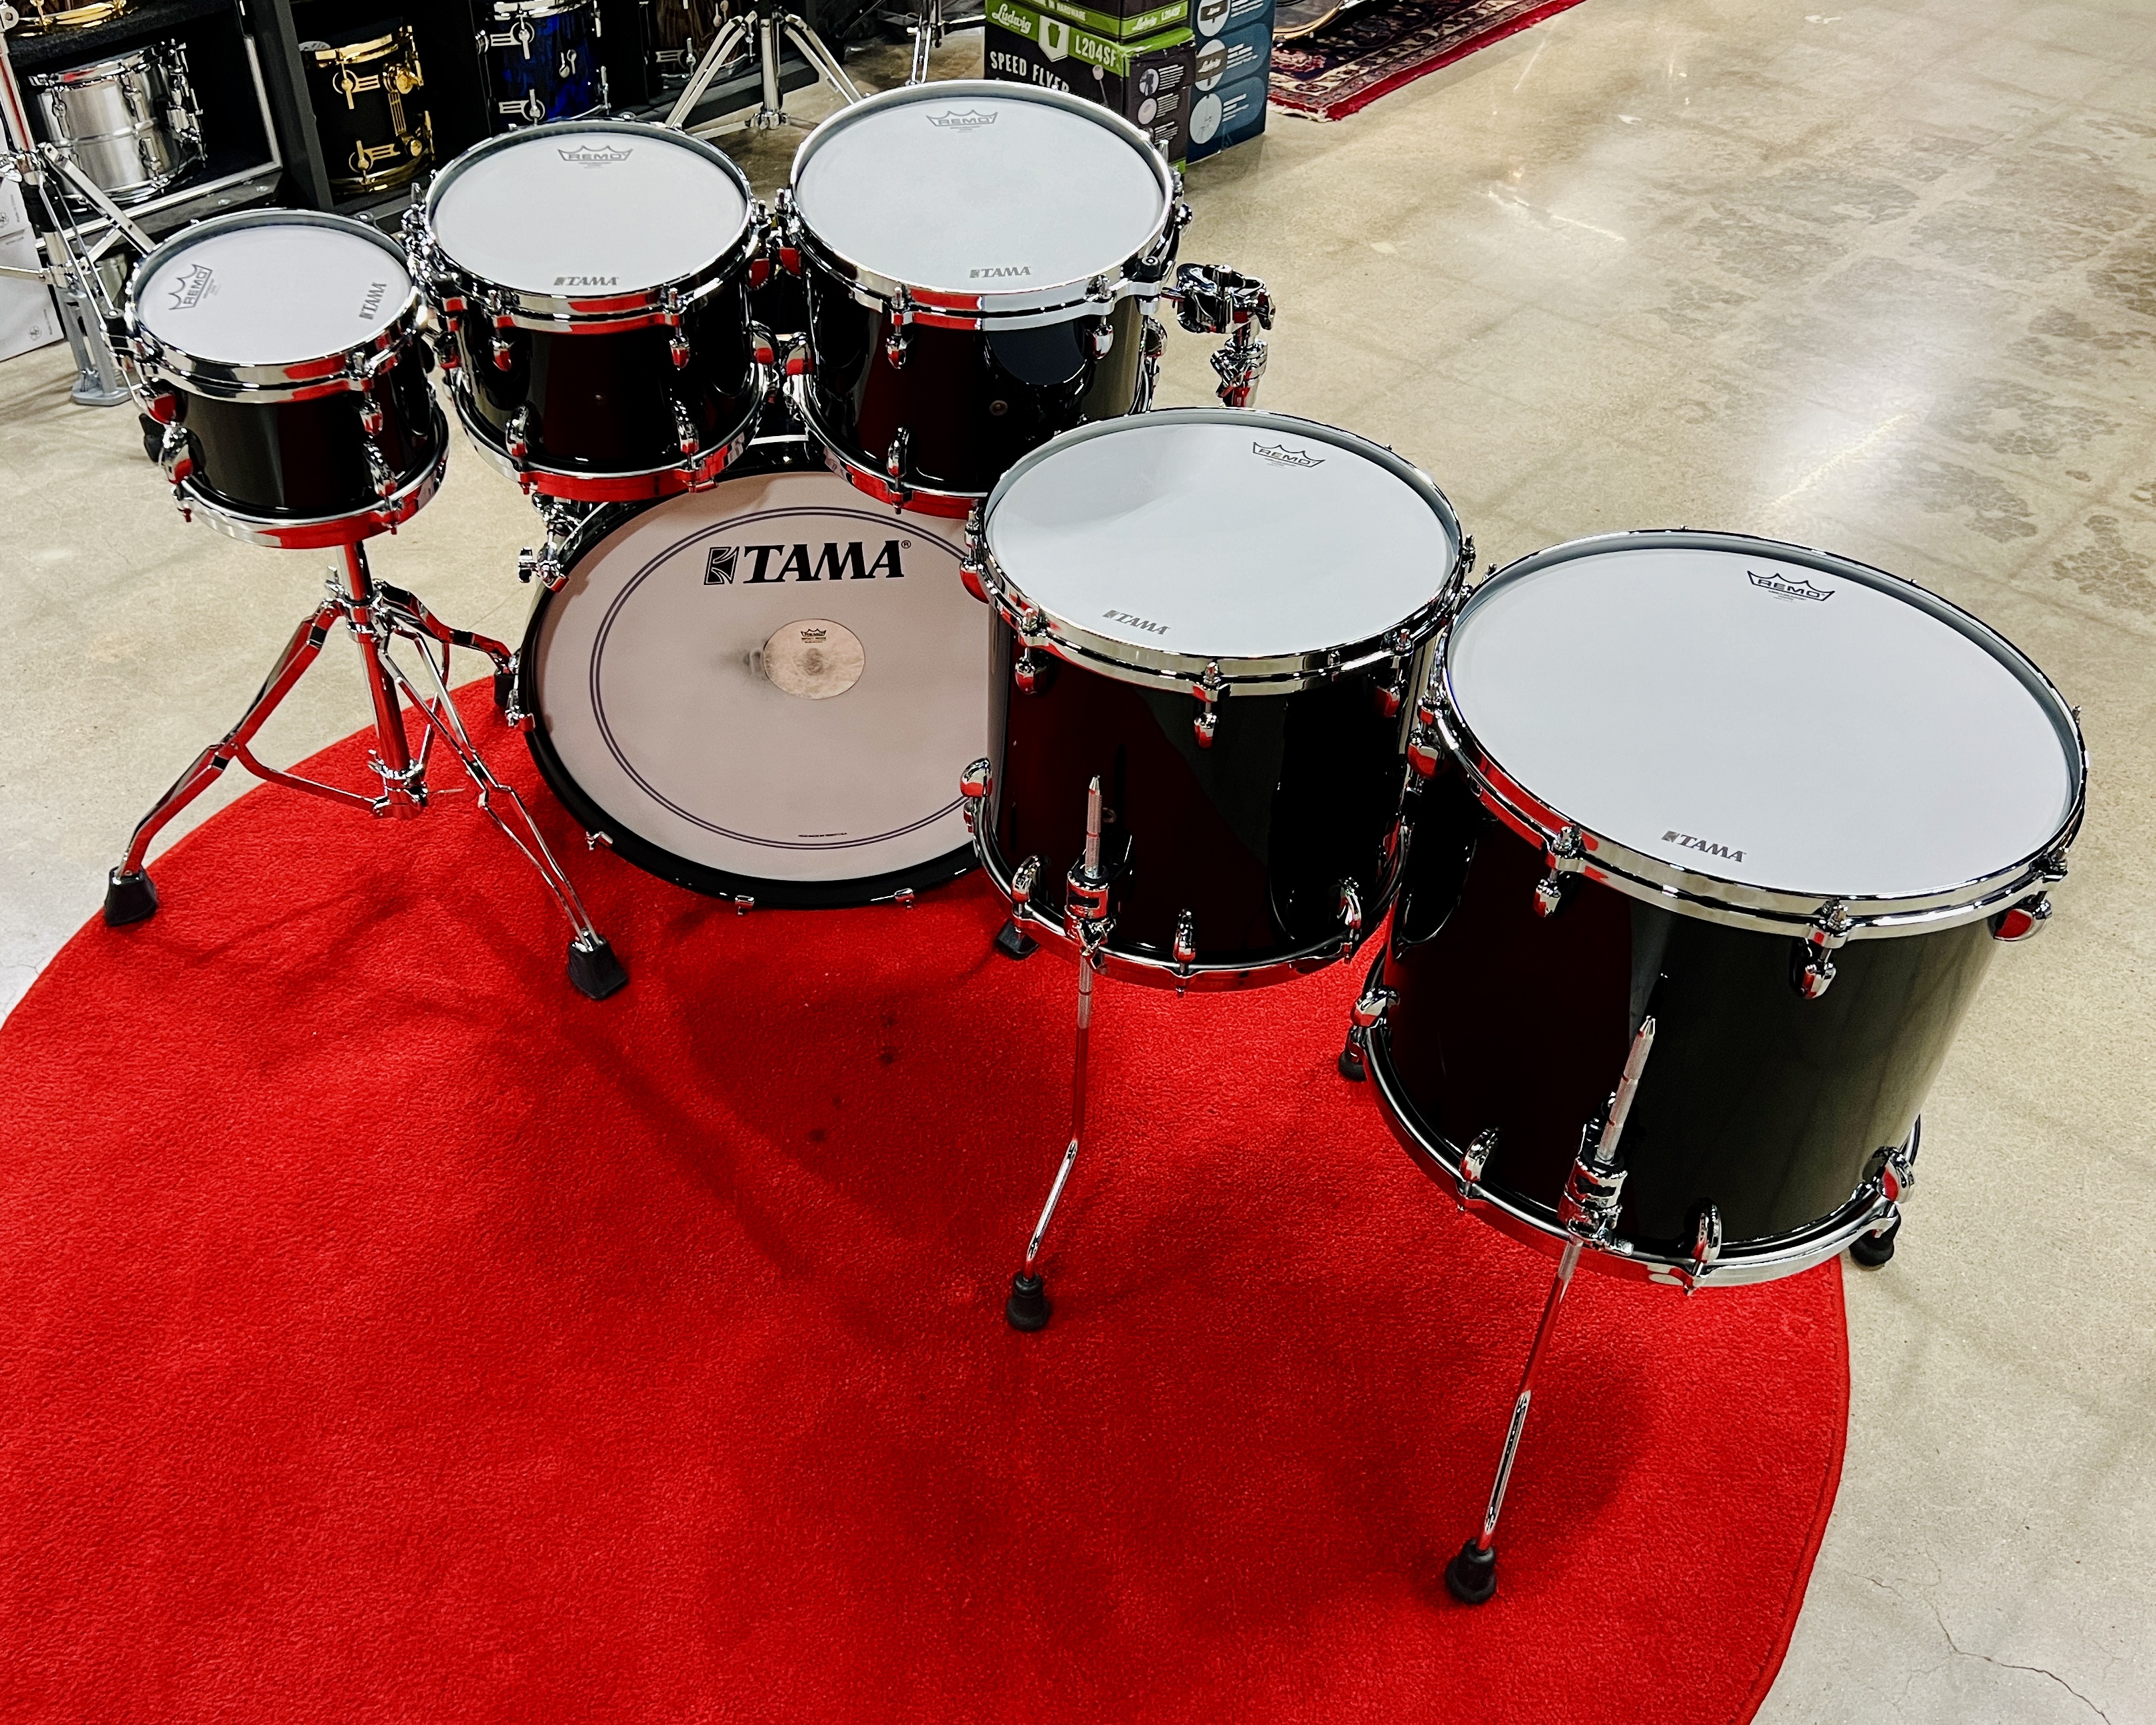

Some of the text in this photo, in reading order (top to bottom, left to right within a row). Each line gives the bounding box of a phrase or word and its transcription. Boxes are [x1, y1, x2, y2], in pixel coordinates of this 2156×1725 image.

[991, 3, 1117, 67] Ludwig L204SF
[990, 51, 1027, 76] SPEED
[938, 117, 990, 126] REMO
[567, 277, 617, 286] TAMA
[981, 266, 1031, 278] TAMA
[183, 271, 208, 304] REMO
[361, 282, 387, 312] TAMA
[1258, 448, 1311, 465] REMO
[742, 540, 905, 584] TAMA
[1757, 579, 1820, 598] REMO
[1113, 613, 1168, 635] TAMA
[1676, 834, 1743, 862] TAMA
